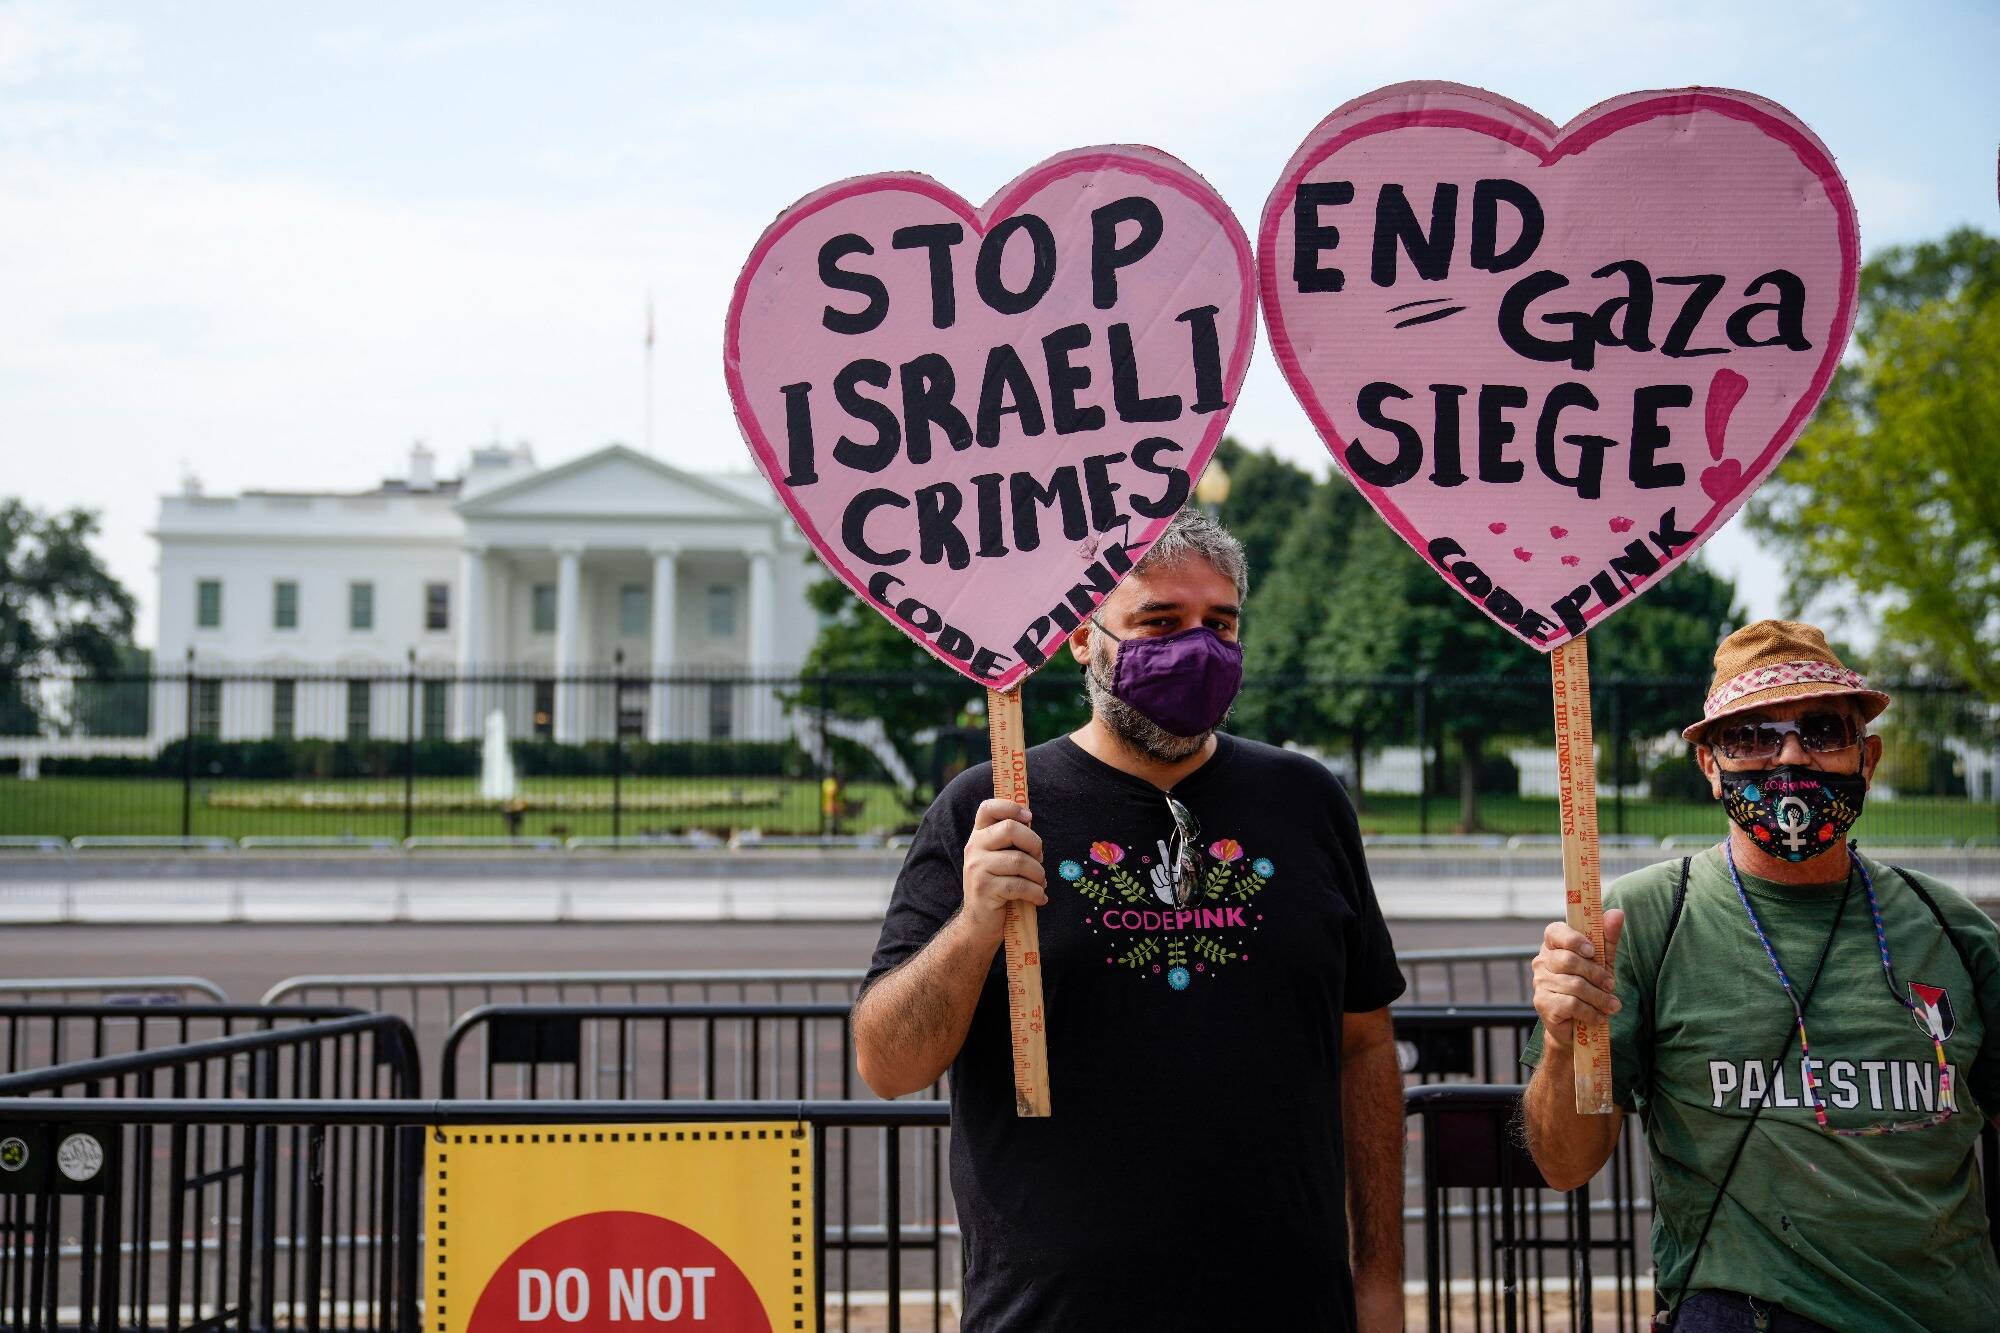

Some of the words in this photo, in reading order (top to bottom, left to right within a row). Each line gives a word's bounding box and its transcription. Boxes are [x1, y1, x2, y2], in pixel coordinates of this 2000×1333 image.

[817, 196, 1164, 336] STOP
[1292, 178, 1545, 294] END
[1497, 260, 1813, 373] Gaza
[780, 304, 1231, 487] ISRAELI
[1344, 368, 1749, 502] SIEGE!
[841, 436, 1192, 571] CRIMES
[868, 571, 1012, 680] CODE
[1012, 517, 1152, 670] PINK
[1427, 536, 1560, 643] CODE
[1550, 506, 1699, 638] PINK
[1554, 681, 1566, 699] OF
[1556, 702, 1569, 731] THE
[1012, 749, 1027, 804] DEPOT
[1558, 733, 1571, 783] FINEST
[1561, 786, 1575, 837] PAINTS
[1103, 907, 1247, 931] CODEPINK
[518, 1267, 590, 1322] DO
[609, 1267, 716, 1321] NOT
